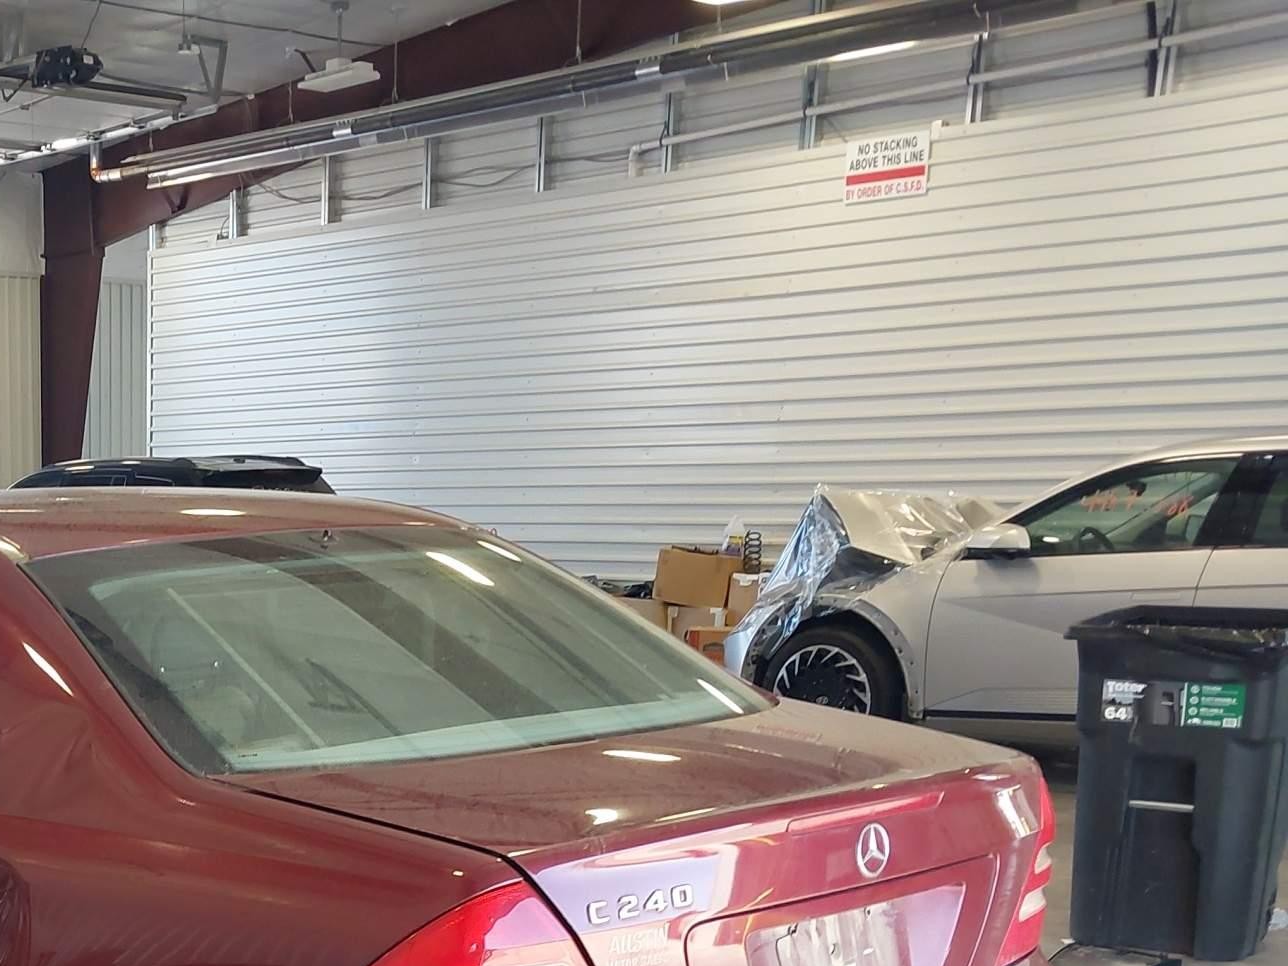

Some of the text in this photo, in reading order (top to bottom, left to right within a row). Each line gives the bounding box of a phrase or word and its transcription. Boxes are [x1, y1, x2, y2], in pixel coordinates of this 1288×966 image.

[857, 136, 918, 156] NO STACKING
[849, 149, 924, 171] ABOVE THIS LINE
[845, 190, 856, 201] BY
[856, 185, 882, 199] ORDER
[884, 184, 894, 195] OF
[1107, 681, 1148, 694] Toter
[1104, 706, 1128, 720] 64
[587, 884, 694, 924] C 240
[608, 921, 669, 955] AUSTIN
